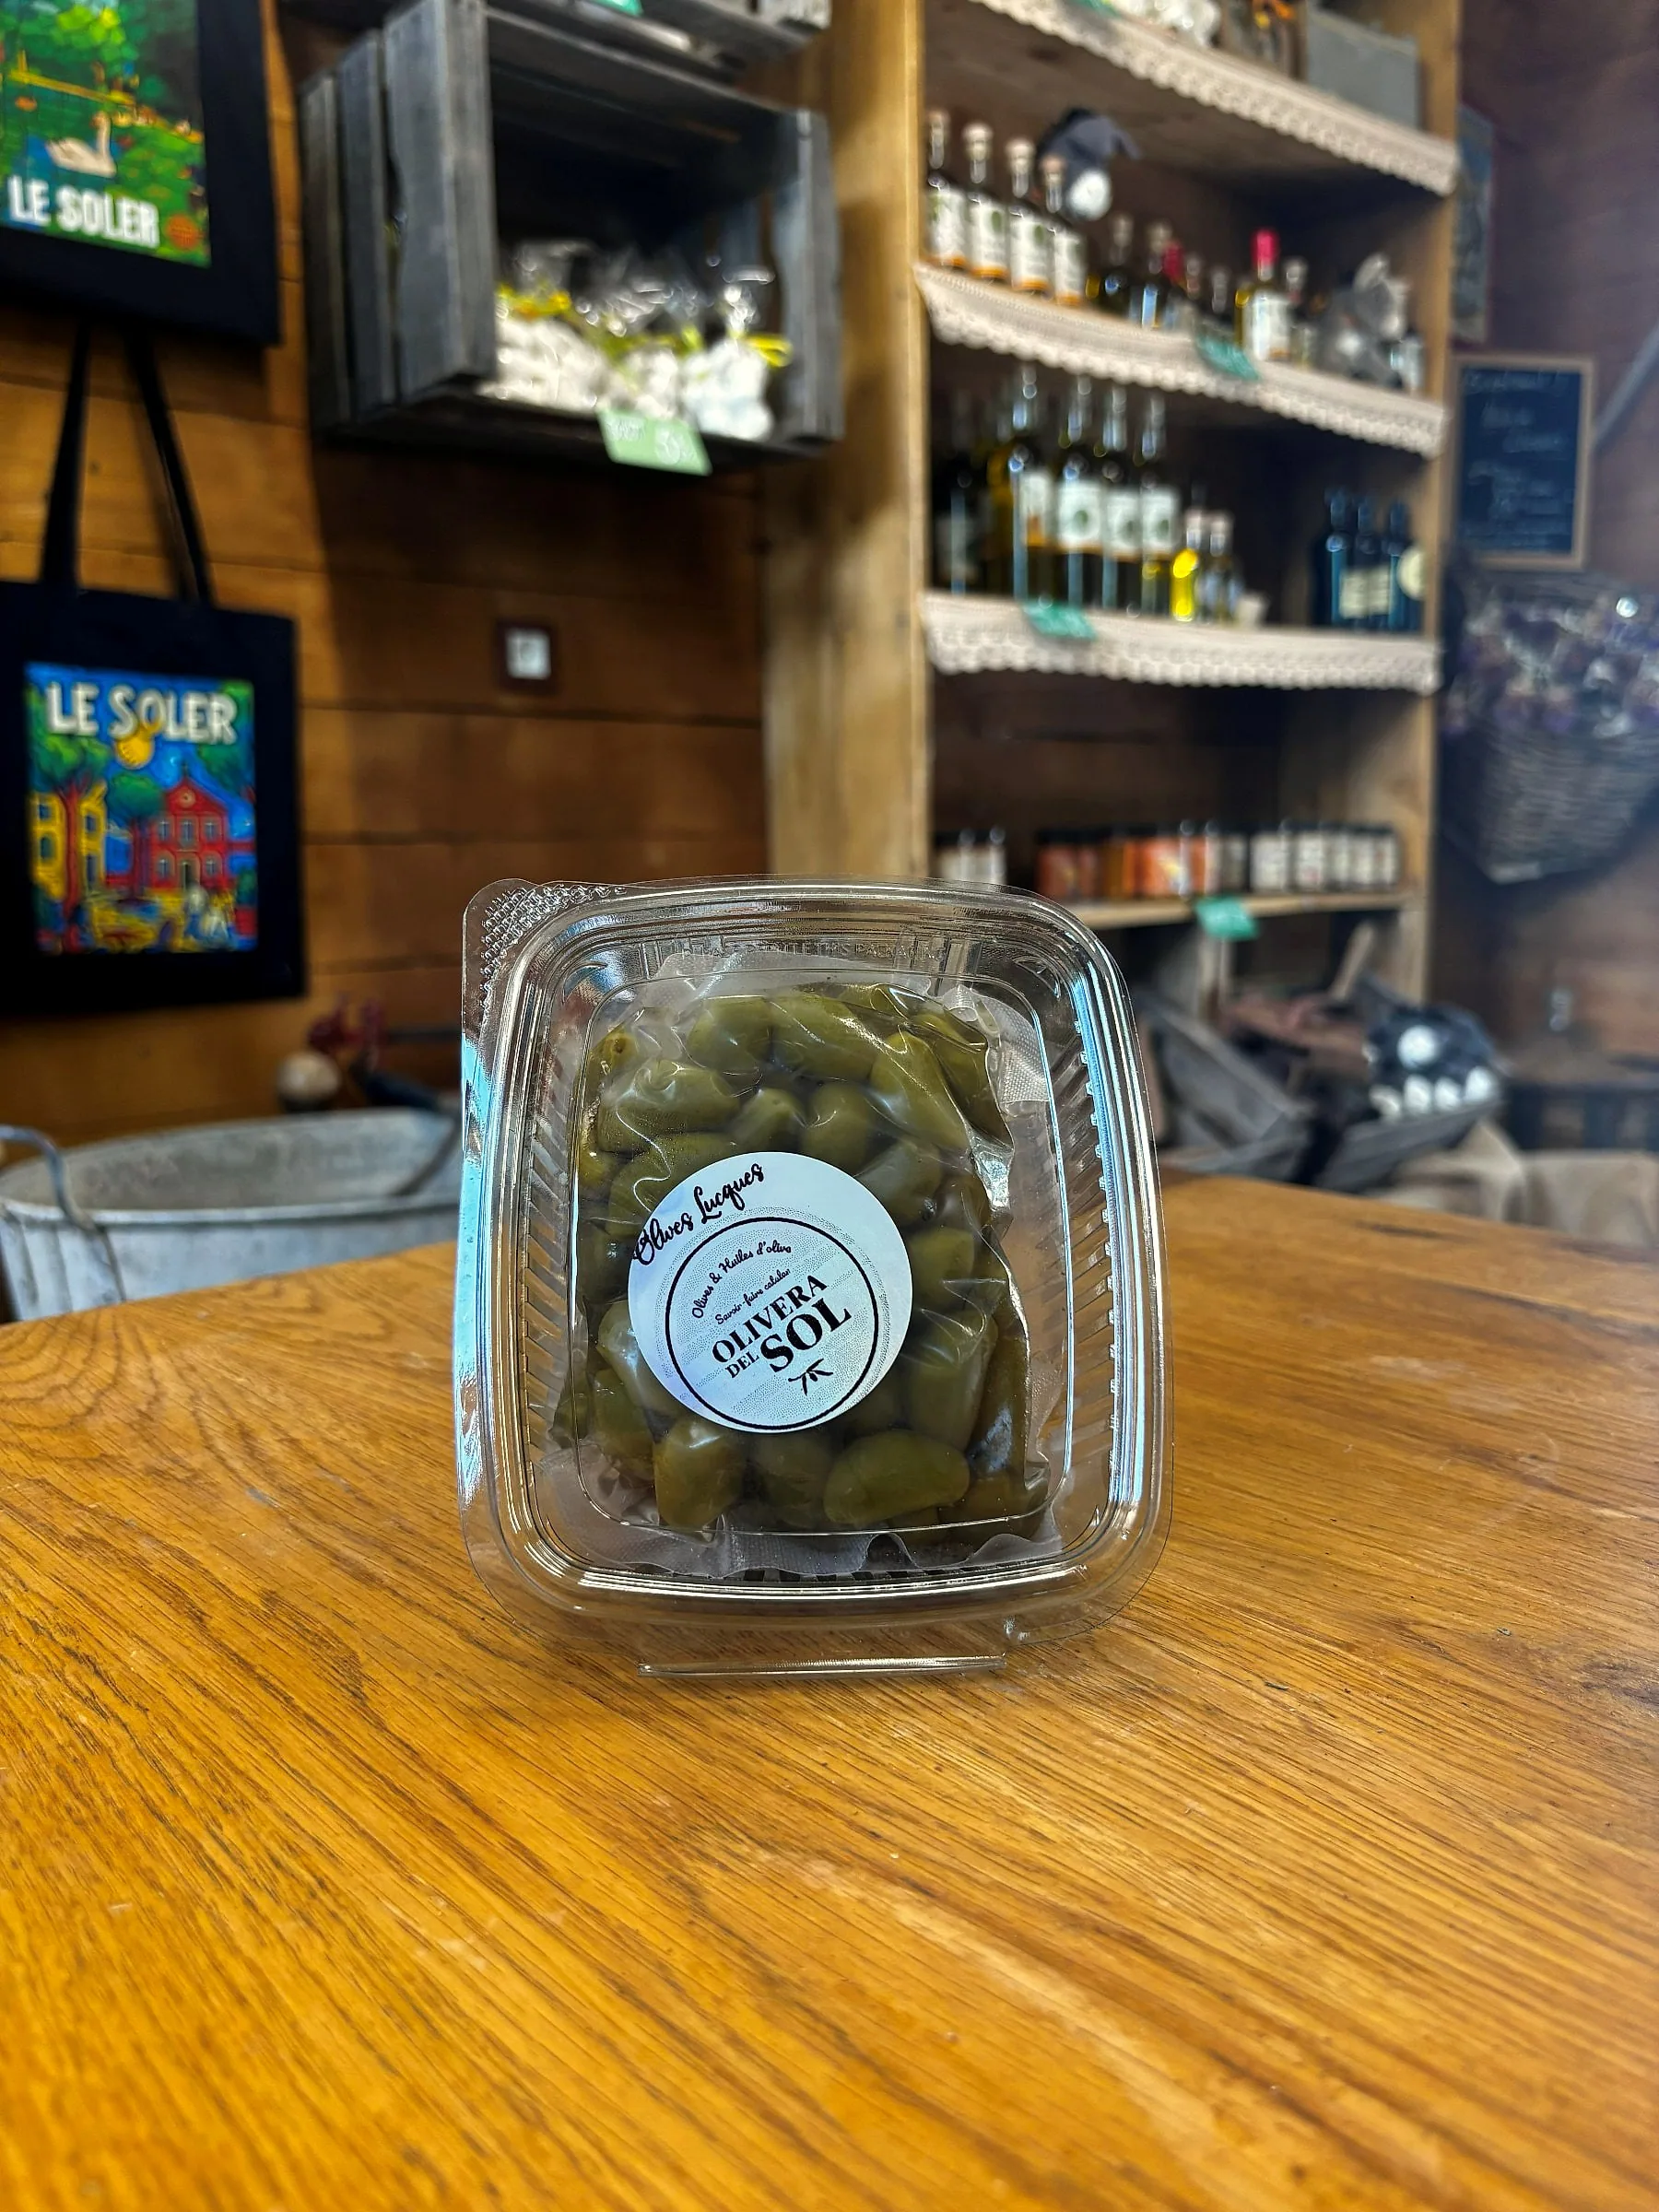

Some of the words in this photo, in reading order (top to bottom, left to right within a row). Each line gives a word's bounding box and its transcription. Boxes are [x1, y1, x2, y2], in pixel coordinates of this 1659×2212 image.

[7, 175, 52, 227] LE
[55, 185, 161, 249] SOLER
[47, 682, 99, 736] LE
[109, 684, 237, 745] SOLER
[633, 1213, 694, 1265] Olives
[694, 1163, 764, 1224] Lucques
[692, 1285, 714, 1318] Olives
[709, 1272, 723, 1284] &
[718, 1249, 754, 1273] Huiles
[712, 1276, 828, 1363] OLIVERA
[725, 1351, 759, 1378] DEL
[760, 1298, 853, 1372] SOL
